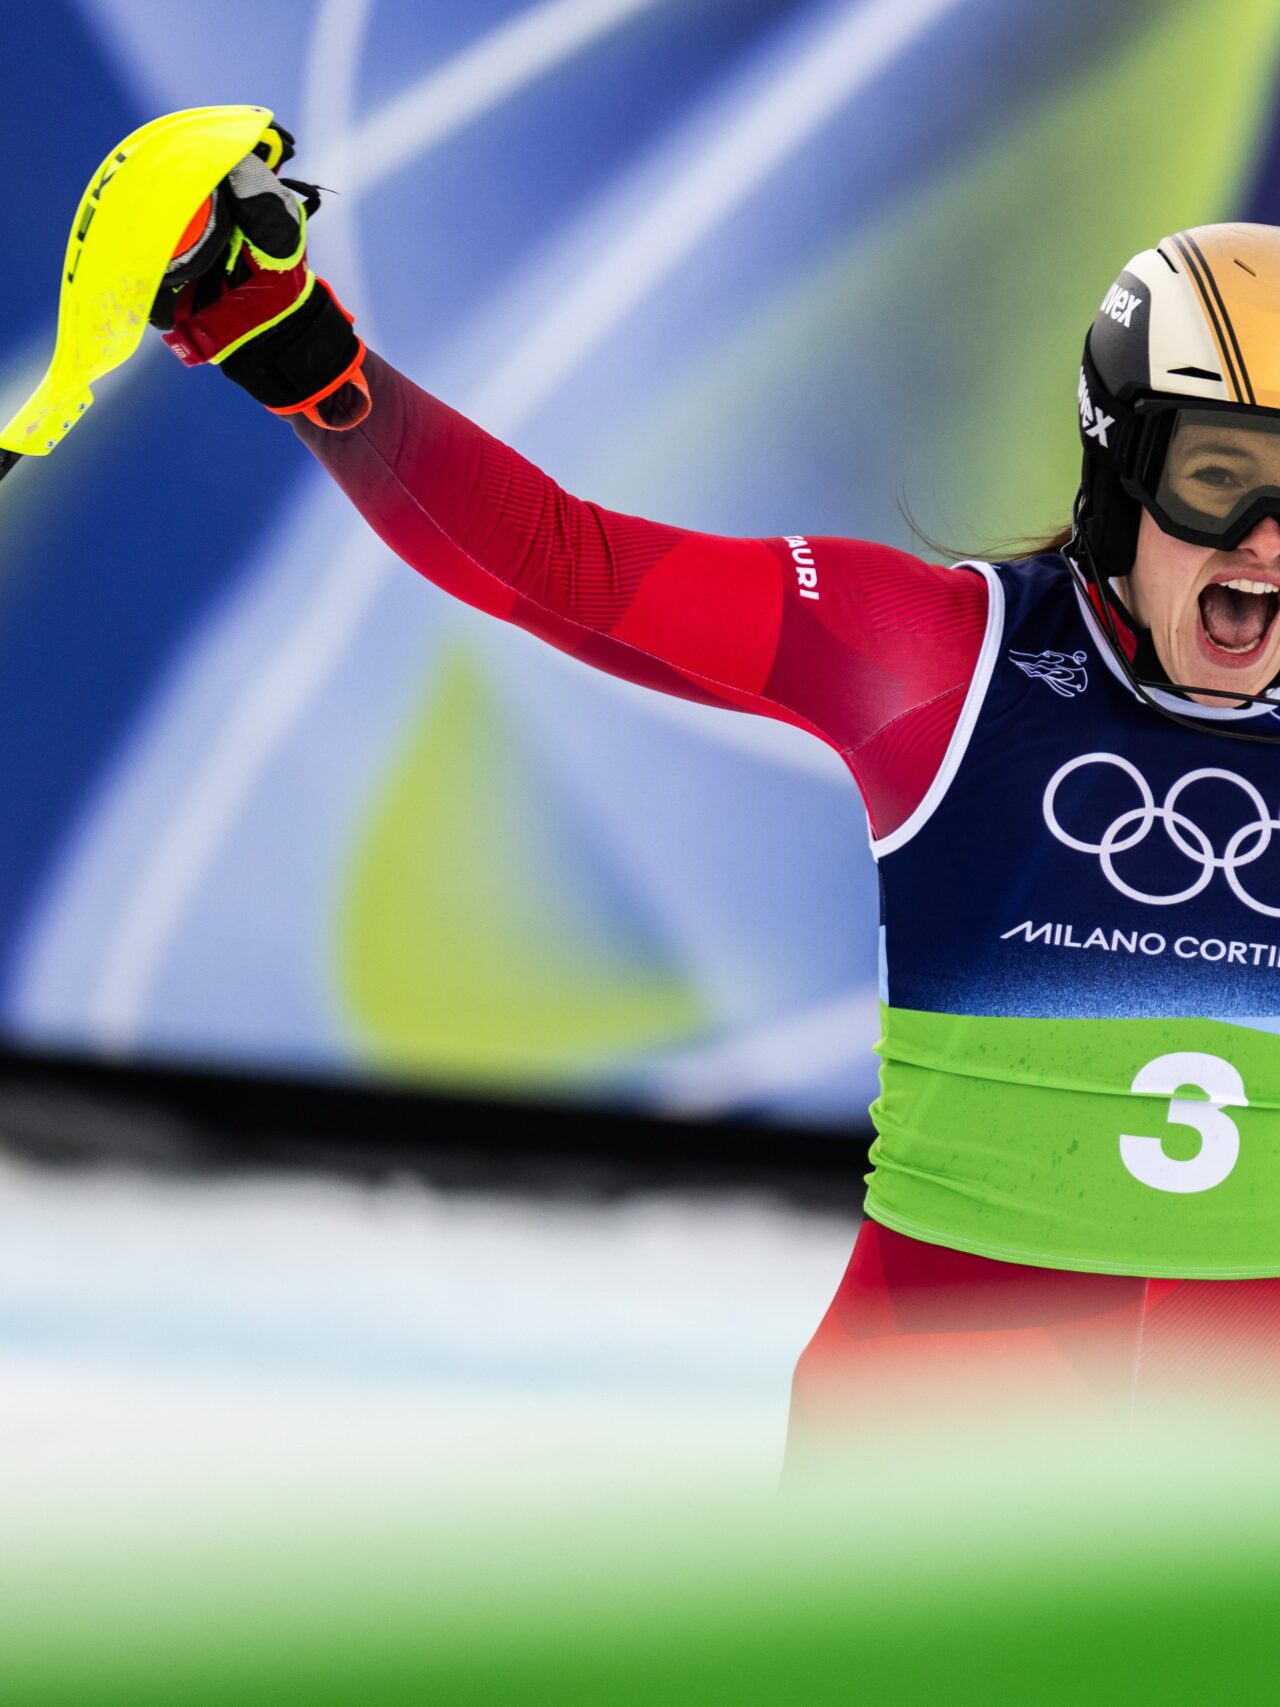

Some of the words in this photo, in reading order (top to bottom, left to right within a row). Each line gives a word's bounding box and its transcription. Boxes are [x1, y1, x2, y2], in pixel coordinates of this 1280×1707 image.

[782, 535, 820, 601] AURI
[1000, 920, 1167, 956] MILANO
[1119, 1051, 1249, 1194] 3
